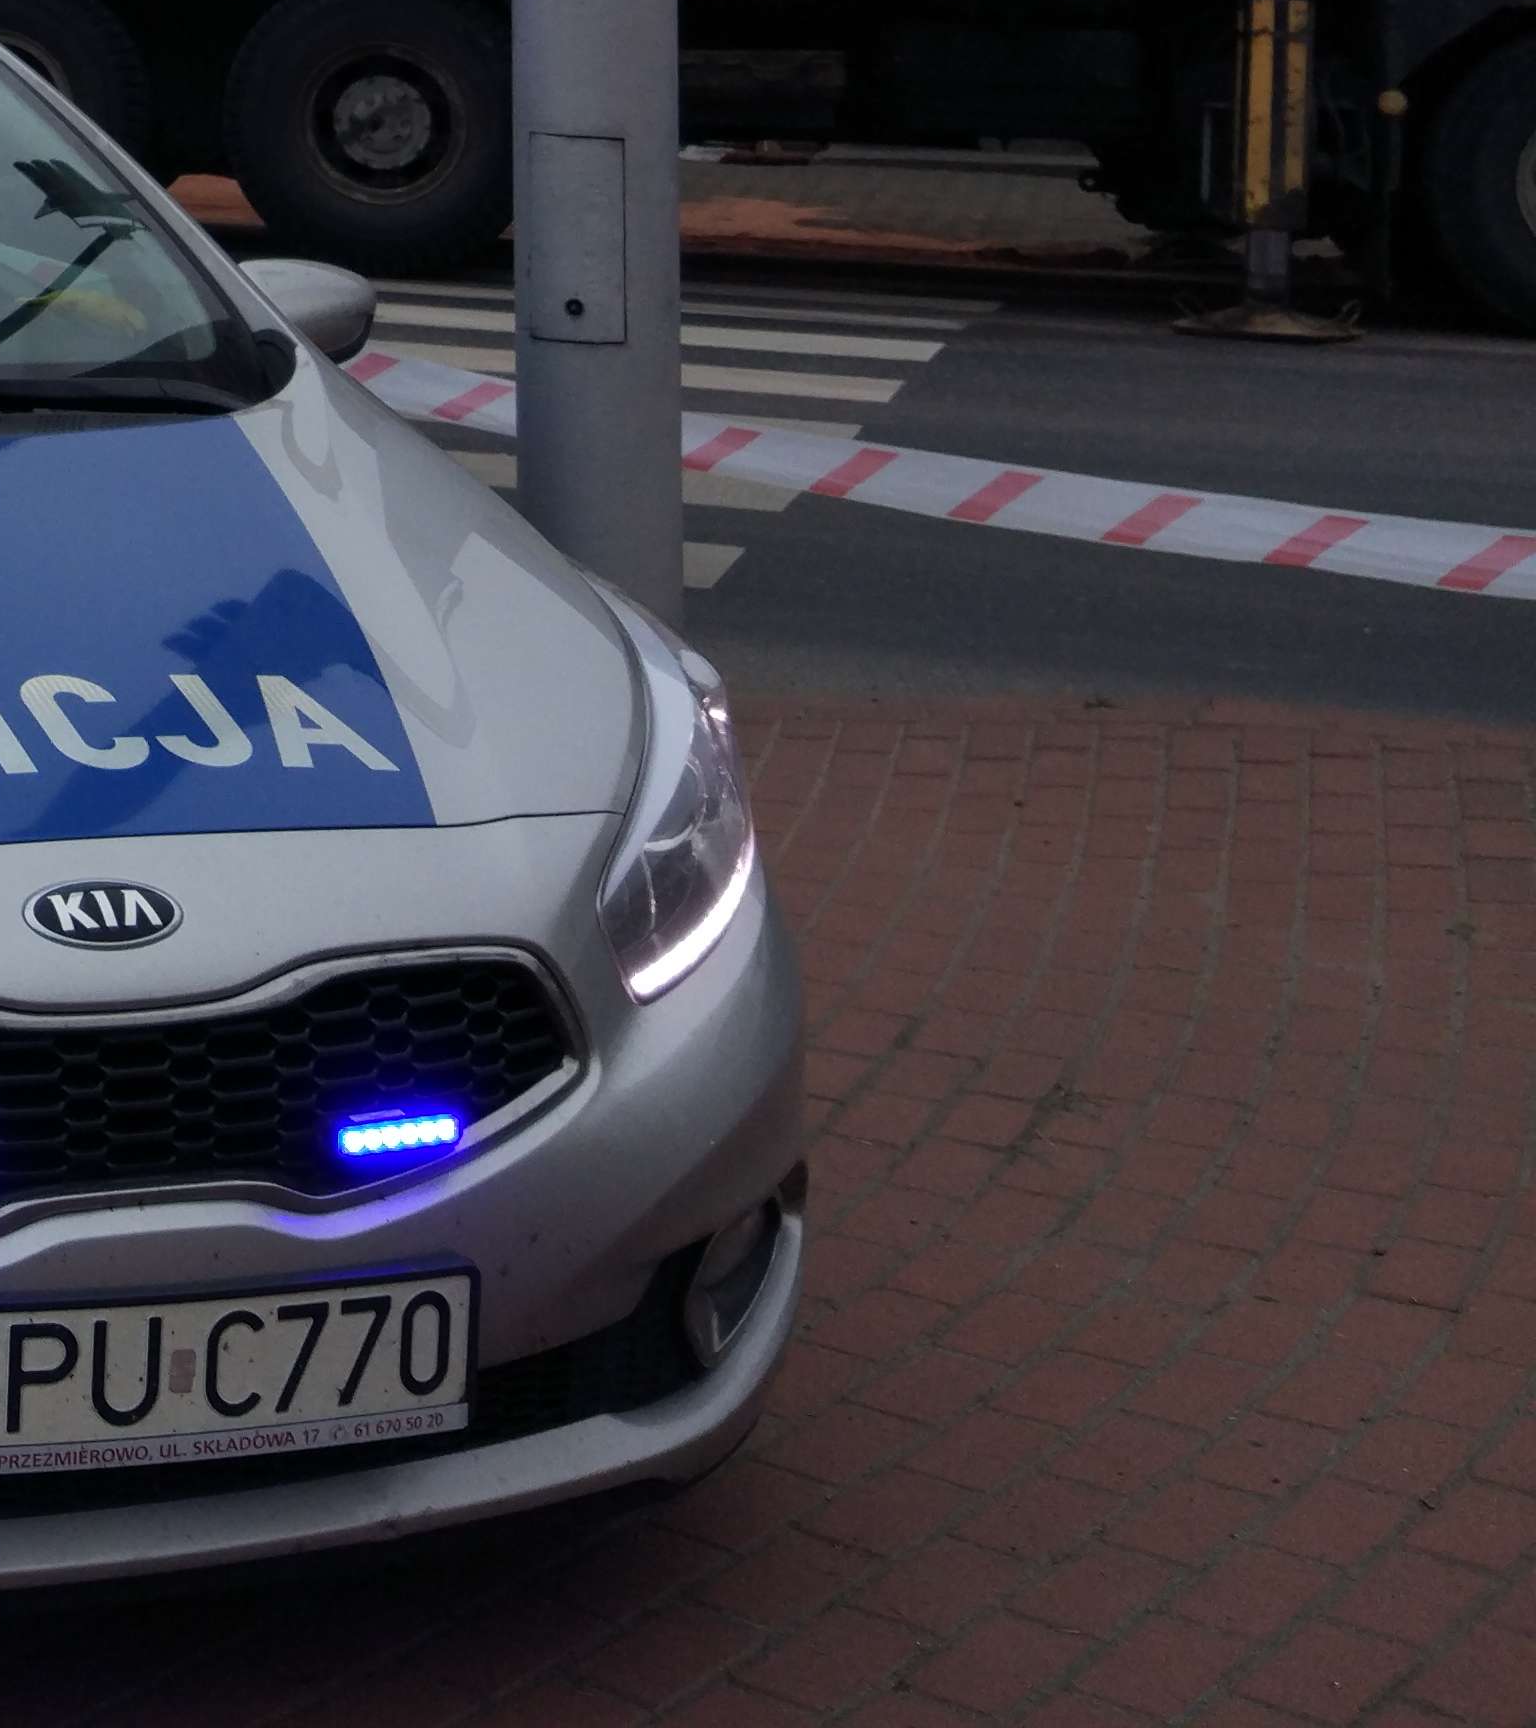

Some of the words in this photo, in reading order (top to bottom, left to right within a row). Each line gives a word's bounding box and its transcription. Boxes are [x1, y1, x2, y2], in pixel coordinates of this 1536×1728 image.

[46, 888, 164, 933] KIA
[205, 1288, 452, 1417] C770
[159, 1443, 187, 1458] UL.
[302, 1428, 321, 1446] 17
[354, 1422, 370, 1438] 61
[375, 1418, 402, 1434] 670
[406, 1415, 424, 1431] 50
[426, 1412, 444, 1428] 20
